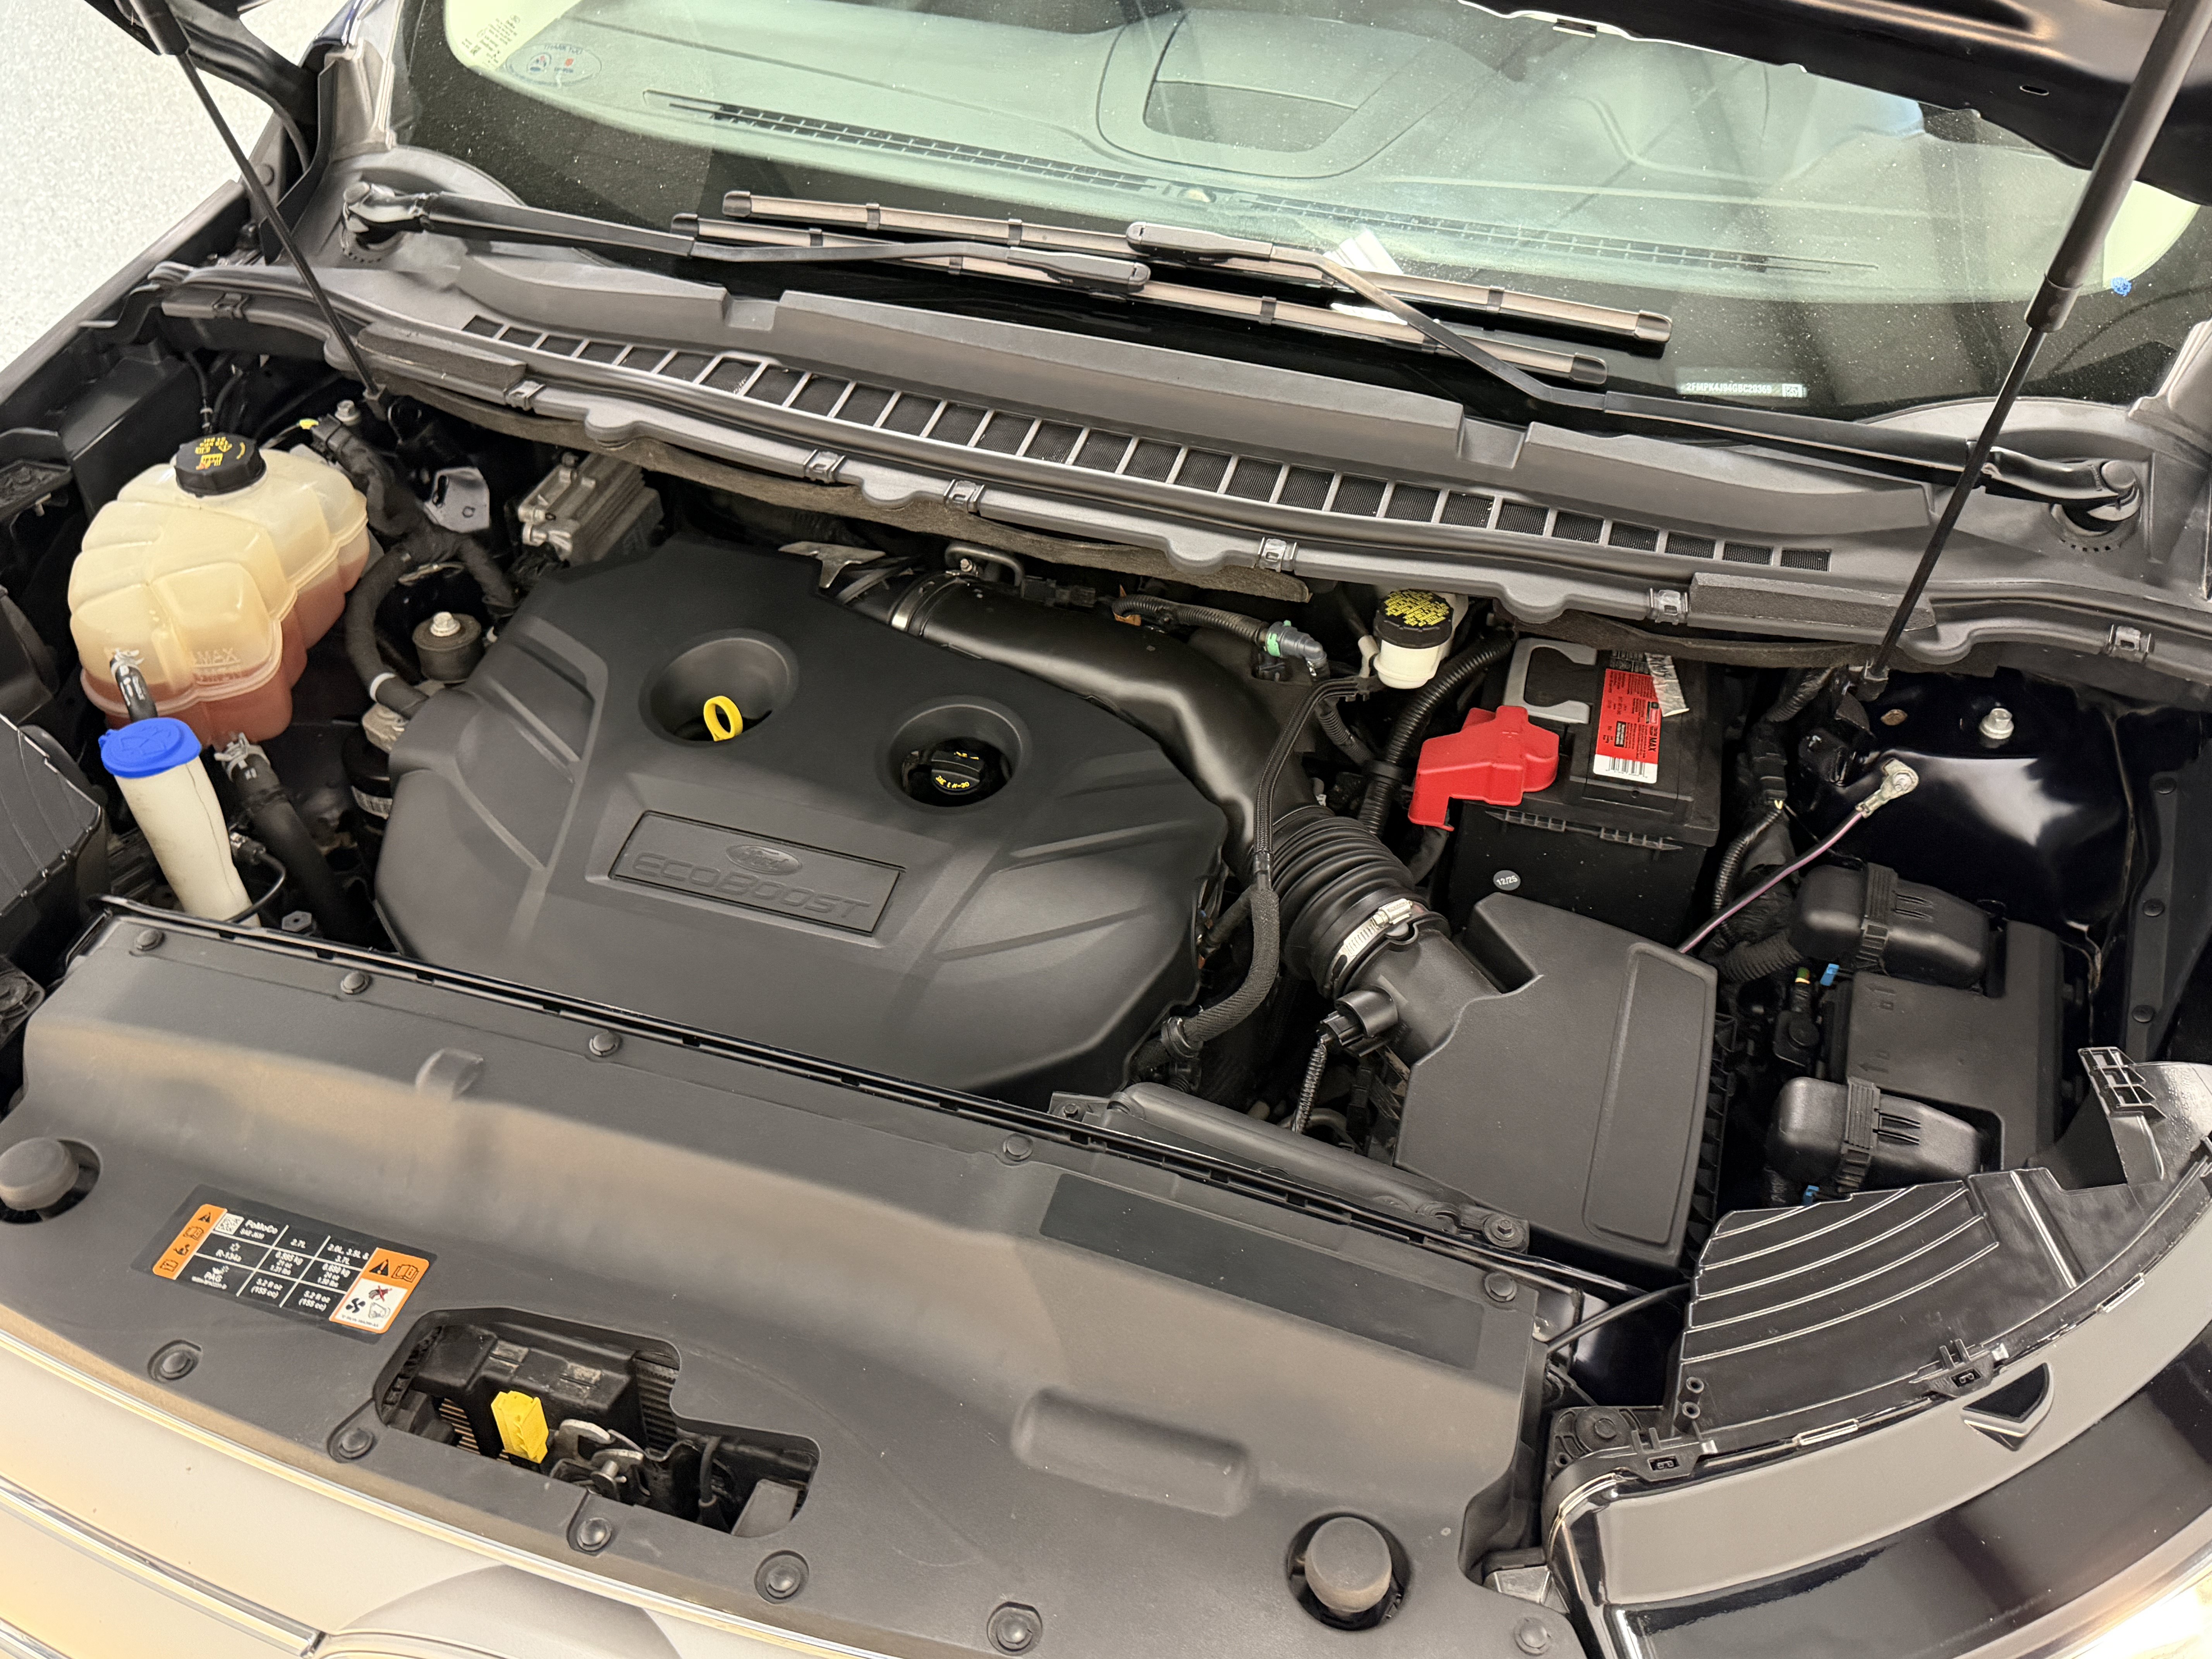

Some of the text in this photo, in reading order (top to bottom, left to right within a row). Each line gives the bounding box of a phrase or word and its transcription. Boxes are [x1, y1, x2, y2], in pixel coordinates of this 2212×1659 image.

[1686, 382, 1772, 394] 2FMPK4J94GBC20369
[195, 647, 238, 665] MAX
[1496, 875, 1518, 886] 12/25
[245, 1219, 278, 1235] FoMoCo
[290, 1238, 306, 1249] 2.7L
[216, 1249, 242, 1262] R-134a
[204, 1271, 223, 1282] PAG
